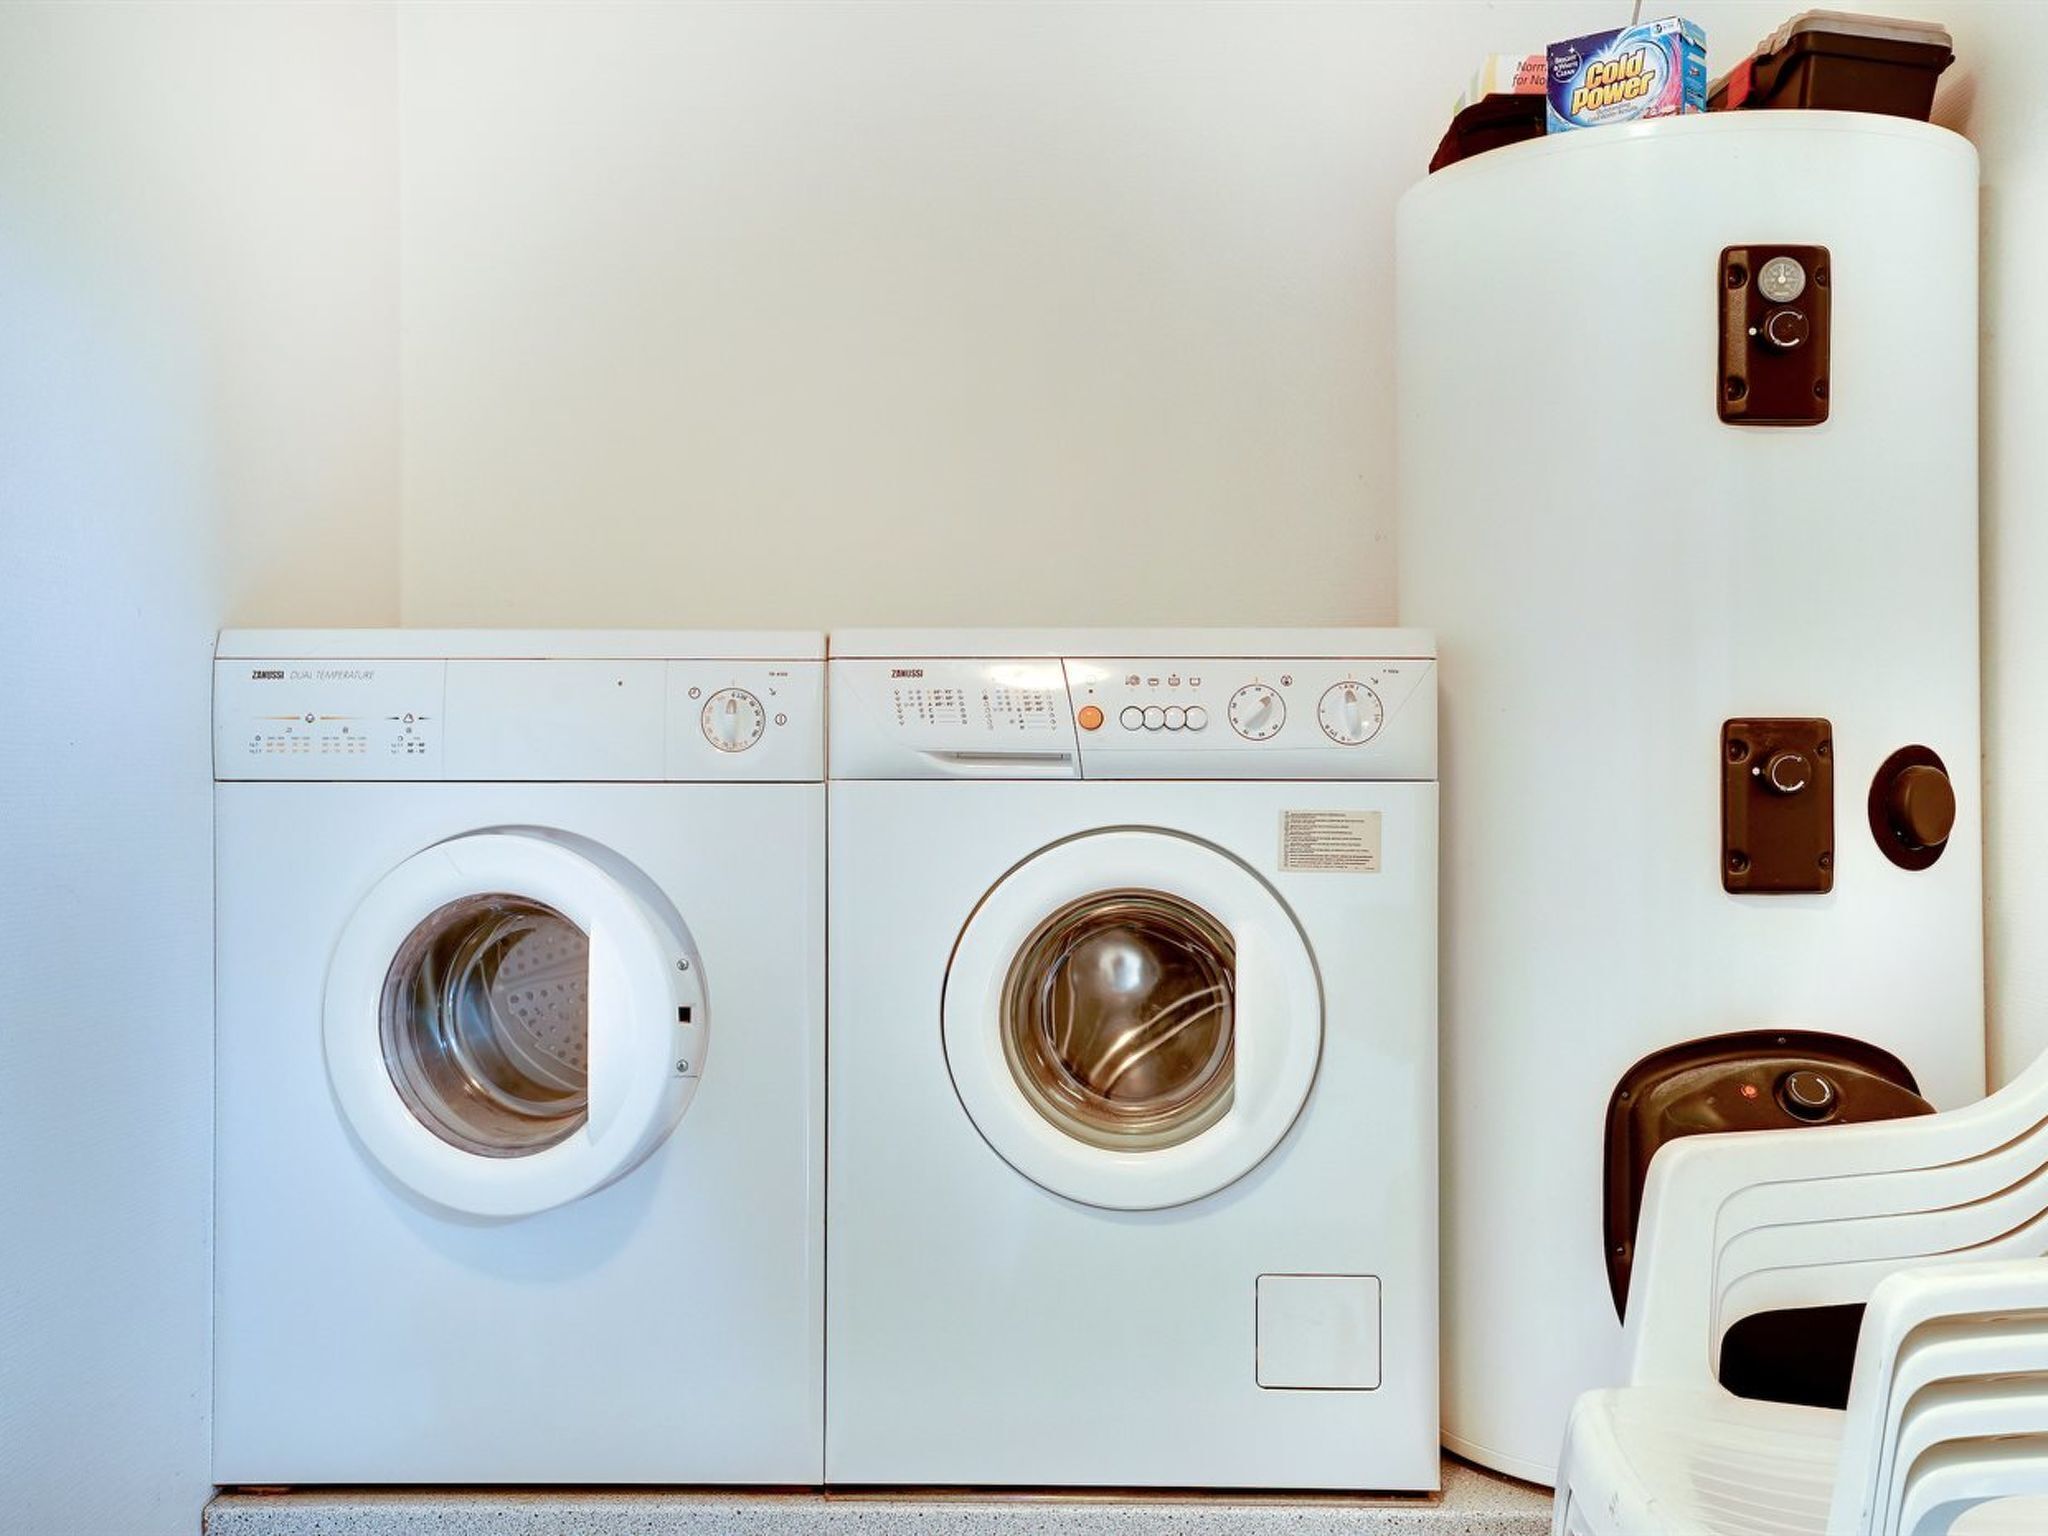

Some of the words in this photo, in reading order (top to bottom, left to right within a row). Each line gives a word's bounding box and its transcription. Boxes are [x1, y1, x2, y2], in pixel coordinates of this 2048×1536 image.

[1516, 61, 1547, 72] Norm
[1586, 48, 1646, 90] Cold
[1512, 74, 1528, 88] for
[252, 670, 285, 680] ZANUSSI
[891, 669, 924, 678] ZANUSSI
